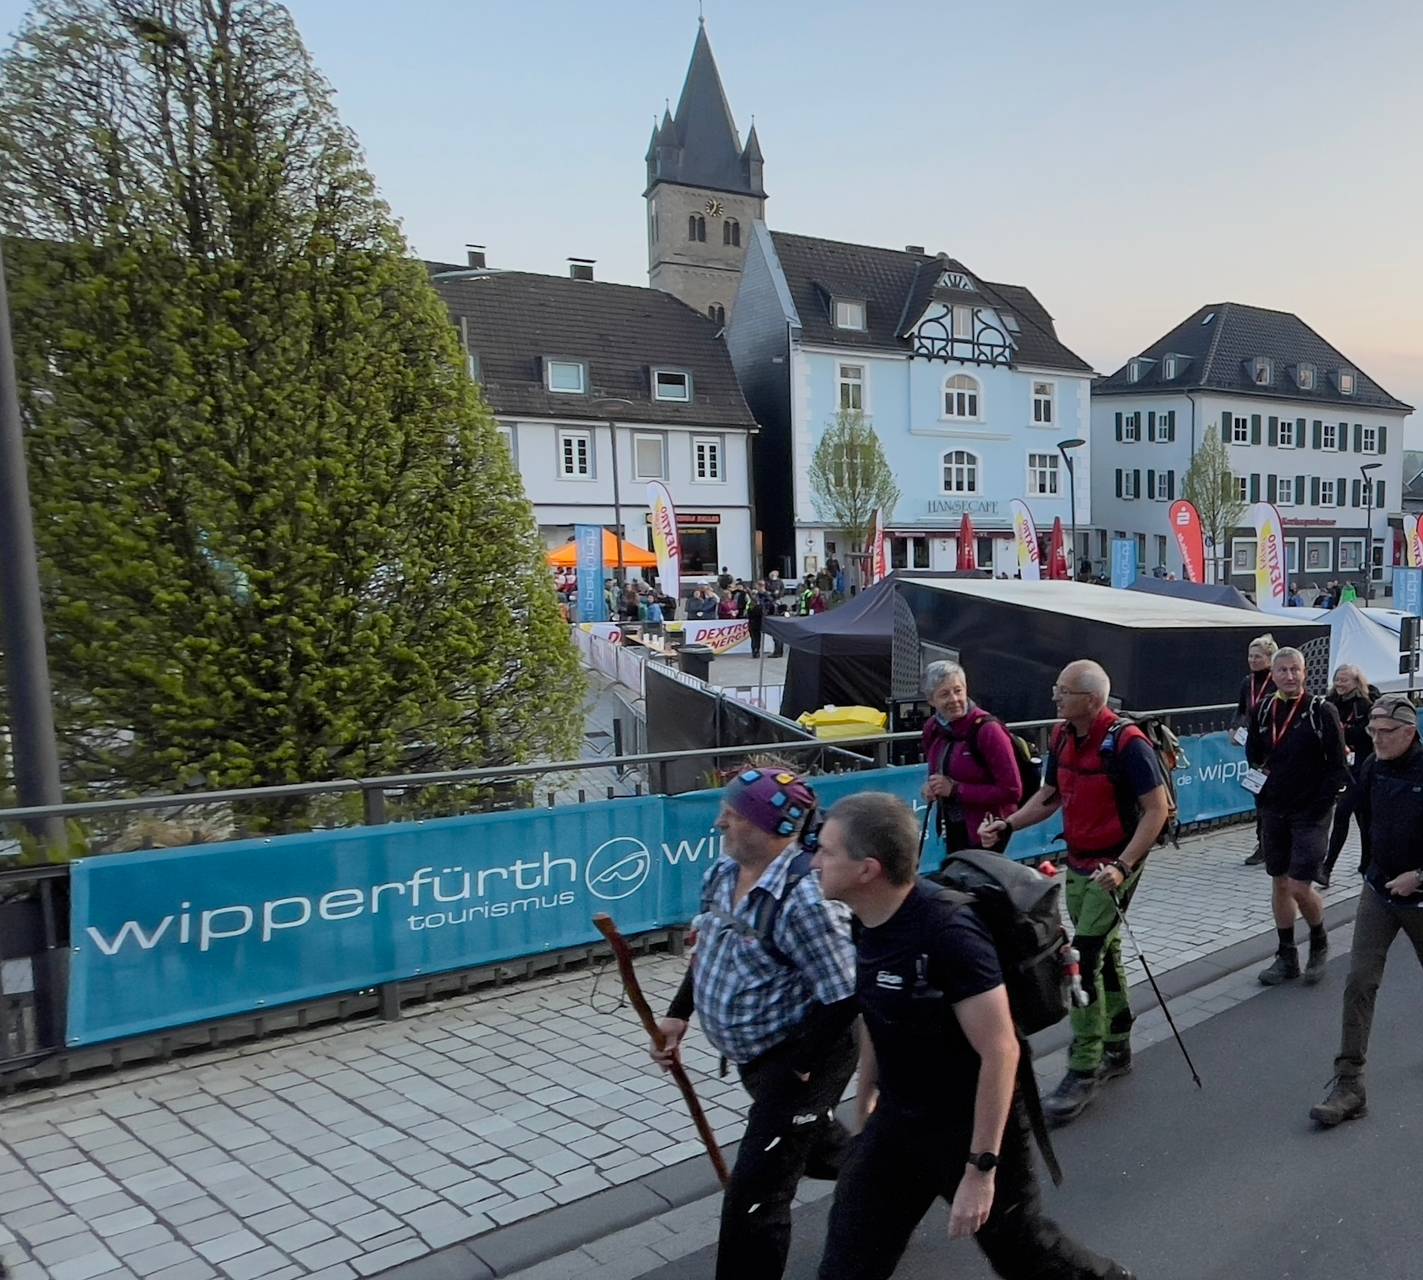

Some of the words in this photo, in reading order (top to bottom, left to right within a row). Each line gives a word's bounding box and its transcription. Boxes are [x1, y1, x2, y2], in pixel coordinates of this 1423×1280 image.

[694, 622, 750, 642] DEXTRO
[86, 851, 577, 955] wipperfürth
[408, 889, 575, 931] tourismus
